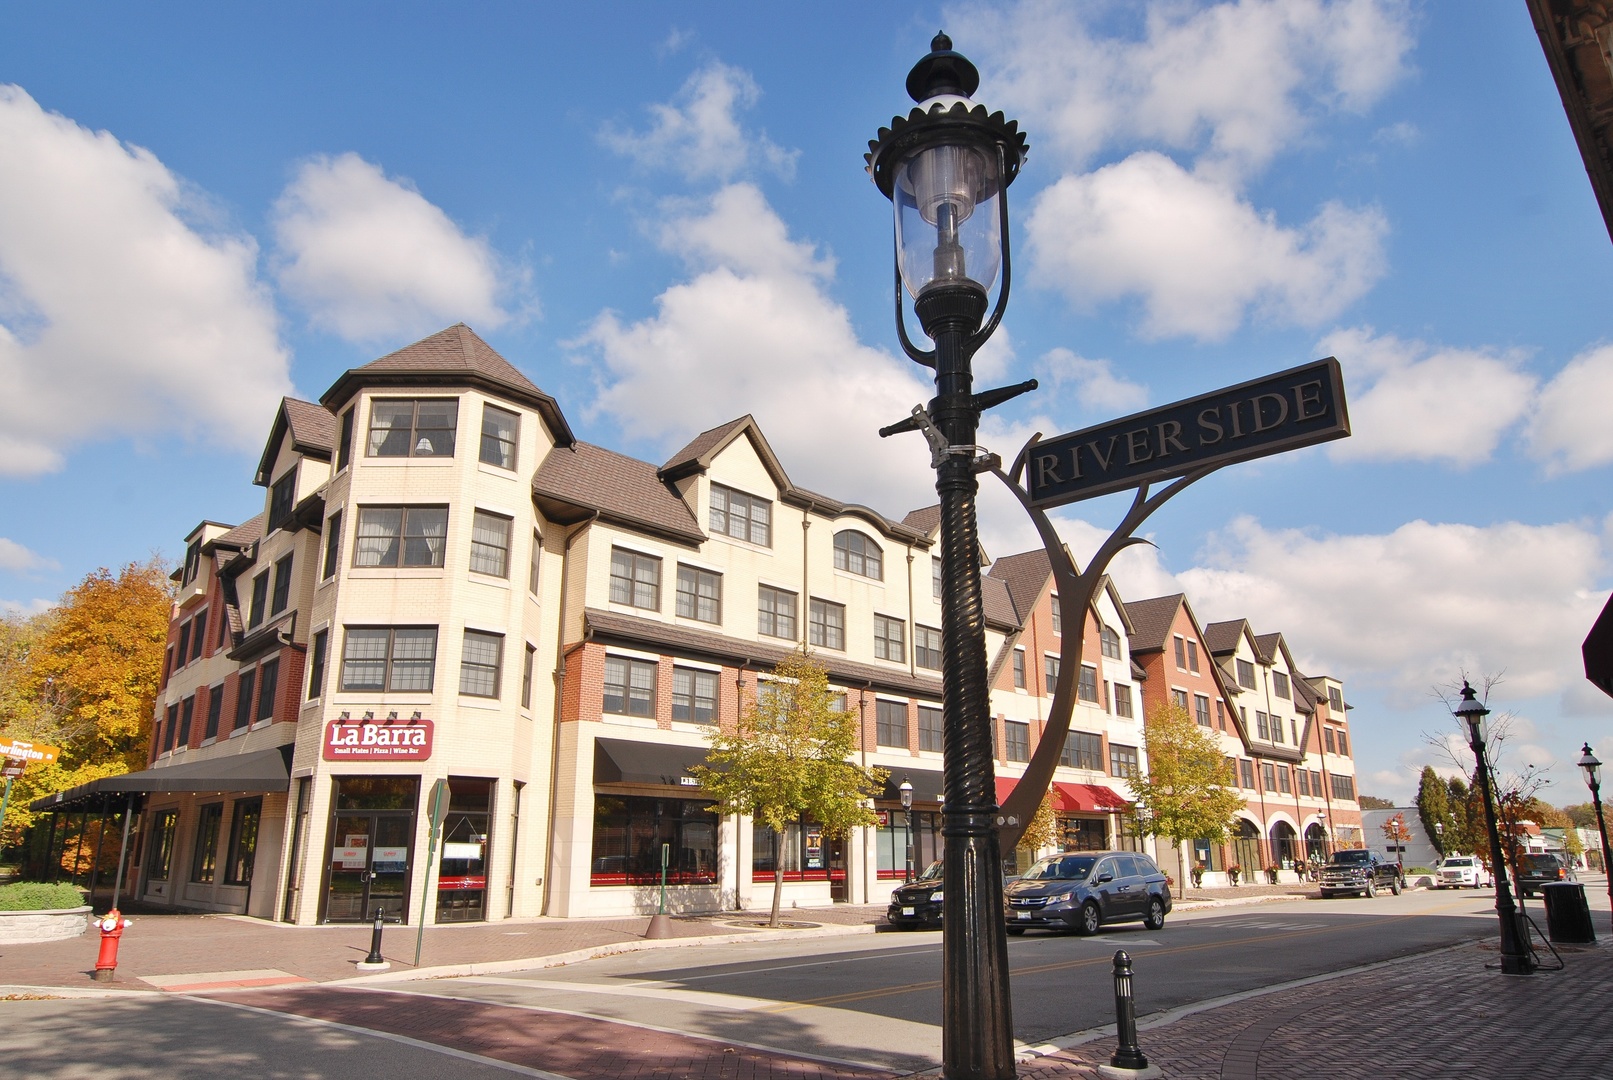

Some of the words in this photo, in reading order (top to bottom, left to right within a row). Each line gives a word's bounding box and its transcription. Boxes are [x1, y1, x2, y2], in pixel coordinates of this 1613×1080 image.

[1035, 379, 1328, 488] RIVERSIDE
[330, 724, 359, 745] La
[361, 724, 427, 745] Barra
[0, 742, 44, 760] urlington
